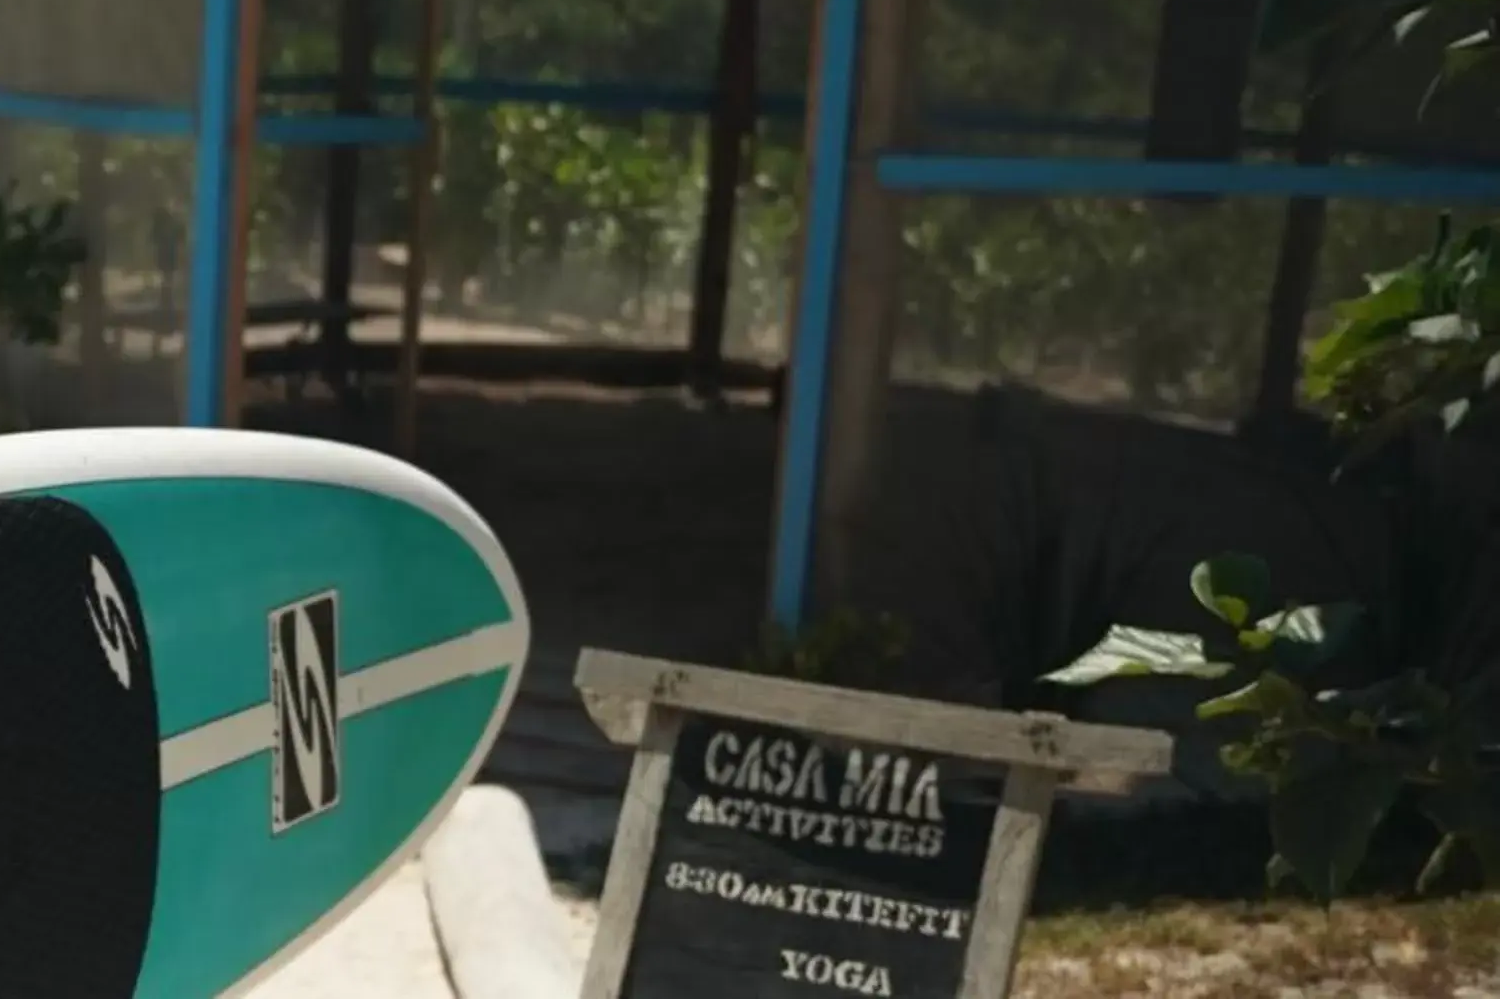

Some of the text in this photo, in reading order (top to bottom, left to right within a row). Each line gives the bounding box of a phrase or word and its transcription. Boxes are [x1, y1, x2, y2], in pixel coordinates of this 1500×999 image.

[704, 730, 943, 820] CASA MIA
[686, 794, 945, 857] ACTIVITIES
[780, 949, 892, 997] YOGA
